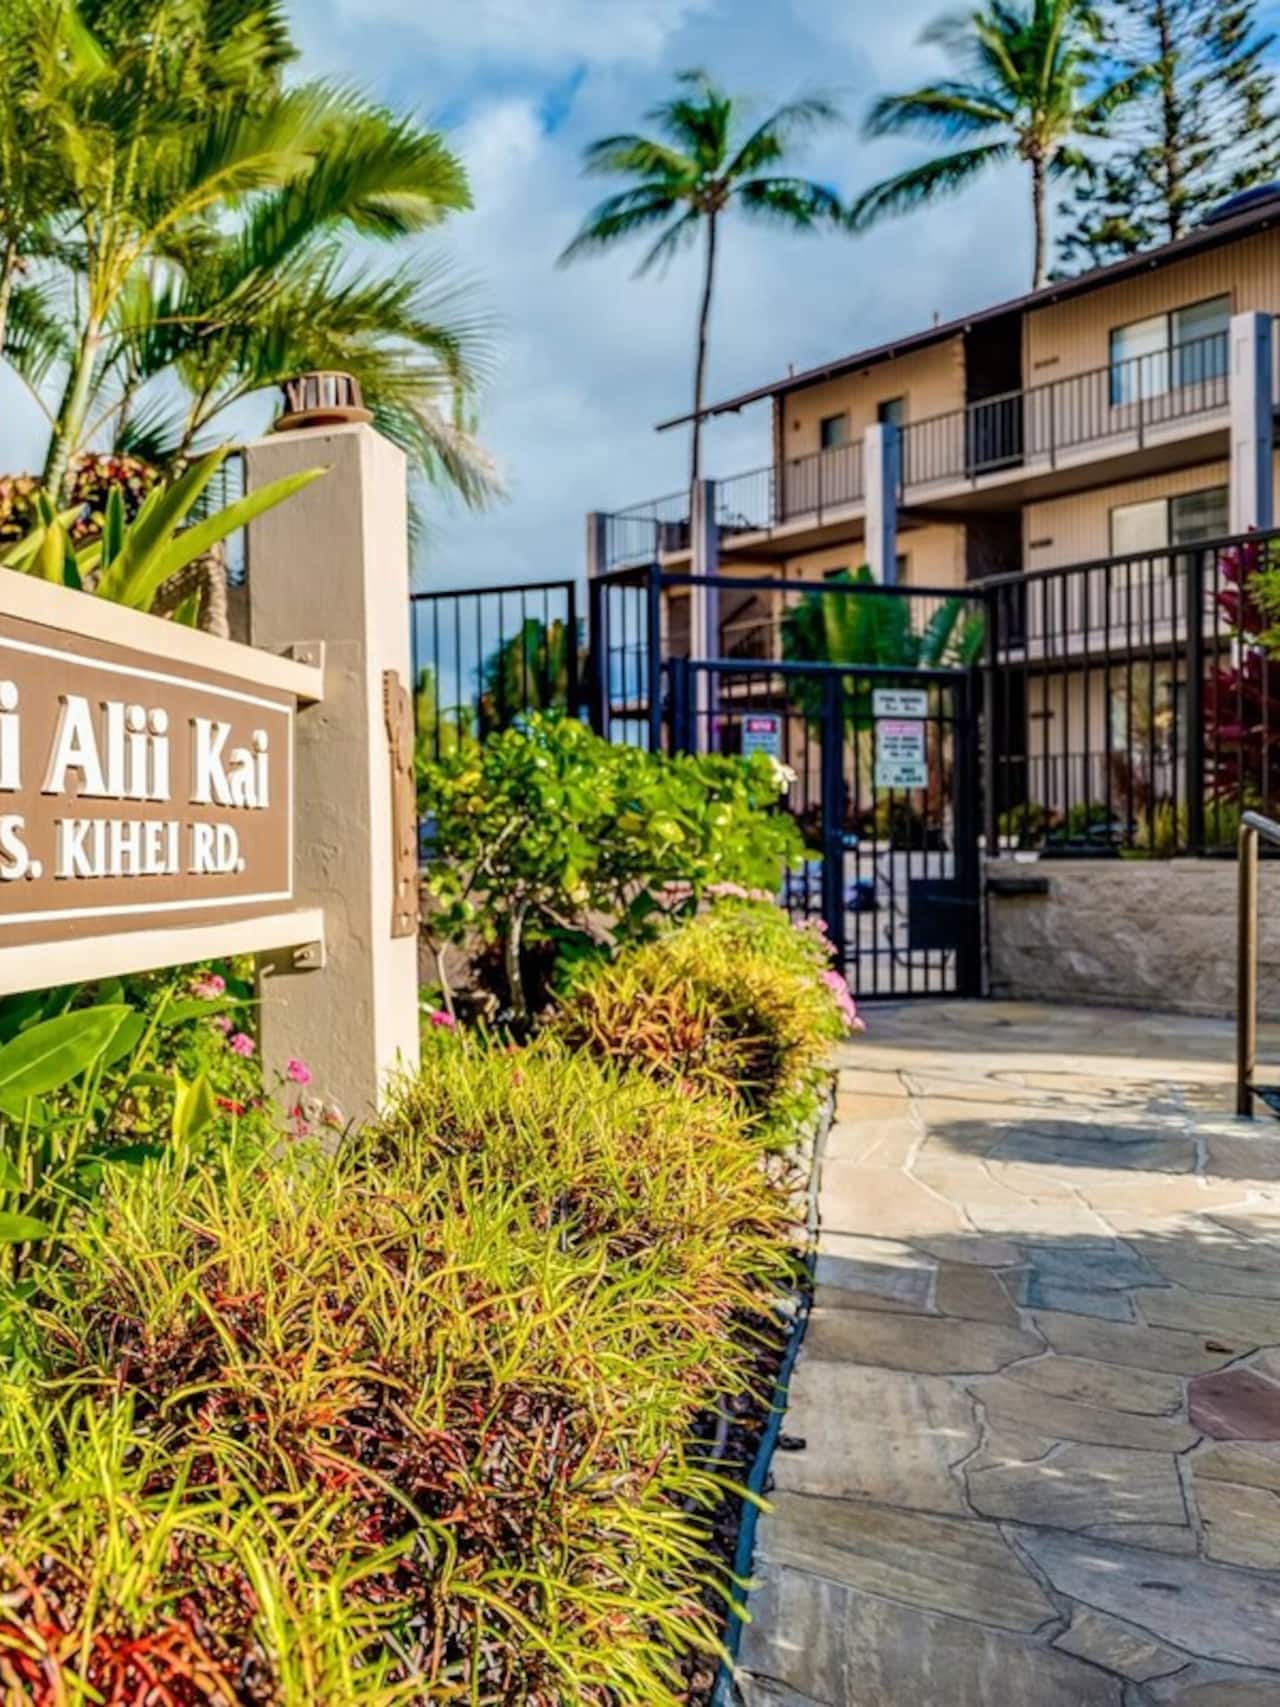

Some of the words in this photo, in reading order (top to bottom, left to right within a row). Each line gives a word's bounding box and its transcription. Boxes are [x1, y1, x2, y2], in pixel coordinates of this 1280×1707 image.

[41, 693, 170, 801] Alii
[188, 716, 270, 808] Kai
[53, 818, 179, 880] KIHEI
[187, 823, 245, 875] RD.
